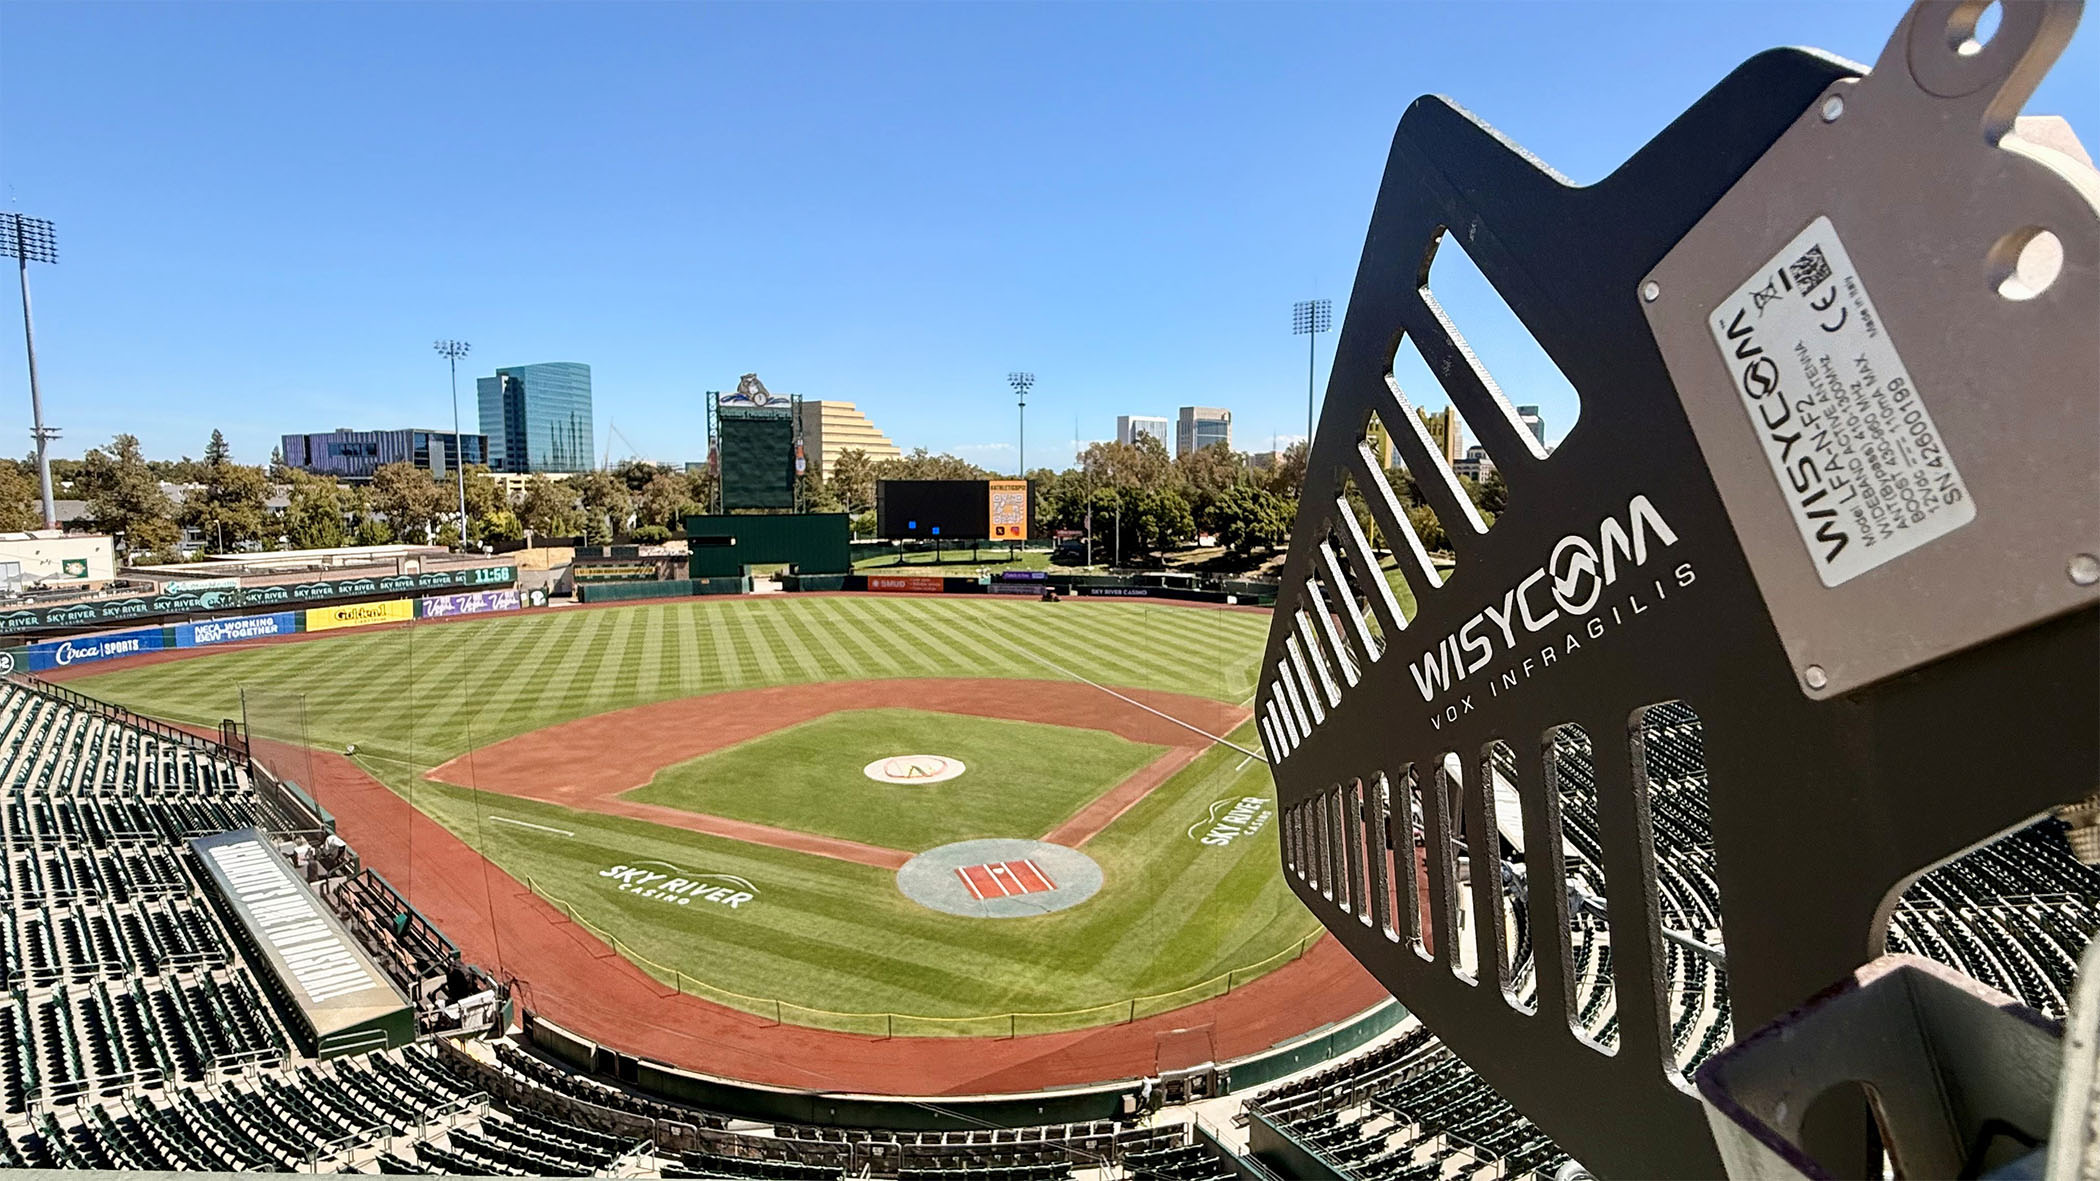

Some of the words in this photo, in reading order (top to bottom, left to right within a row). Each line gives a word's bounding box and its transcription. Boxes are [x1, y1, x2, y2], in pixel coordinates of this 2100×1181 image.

[1793, 339, 1830, 403] ANTENNA
[1853, 352, 1877, 387] MAX
[1849, 379, 1871, 413] MHz
[1870, 386, 1900, 434] 110mA
[1726, 308, 1849, 564] WISYCOM
[1822, 403, 1856, 455] ACTIVE
[1862, 411, 1897, 466] 430-960
[1886, 376, 1943, 468] 42600199
[1794, 393, 1857, 504] LFA-N-F2
[1847, 456, 1894, 539] WIDEBAND
[1859, 441, 1909, 529] ANT(Bypass)
[1889, 471, 1926, 524] BOOST
[1912, 468, 1940, 514] 12Vdc
[1849, 504, 1876, 547] Model
[246, 594, 262, 602] SKY
[264, 591, 289, 600] RIVER
[294, 590, 309, 598] SKY
[311, 587, 334, 596] RIVER
[354, 583, 376, 592] RIVER
[395, 580, 415, 588] RIVER
[432, 576, 451, 584] RIVER
[1123, 588, 1148, 596] CASINO
[102, 607, 120, 616] SKY
[122, 604, 148, 613] RIVER
[153, 602, 171, 610] SKY
[174, 599, 201, 608] RIVER
[1409, 494, 1679, 702] WISYCOM
[9, 616, 39, 627] RIVER
[46, 614, 67, 623] SKY
[69, 610, 96, 620] RIVER
[194, 623, 220, 634] NECA
[225, 617, 274, 631] WORKING
[226, 625, 279, 639] TOGETHER
[56, 641, 100, 665] Circa
[104, 638, 140, 655] SPORTS
[1430, 694, 1474, 730] VOX
[1490, 562, 1697, 697] INFRAGILIS
[1200, 822, 1241, 846] SKY
[1221, 796, 1272, 825] RIVER
[599, 865, 668, 885] SKY
[657, 877, 754, 909] RIVER
[618, 883, 691, 905] CASINO
